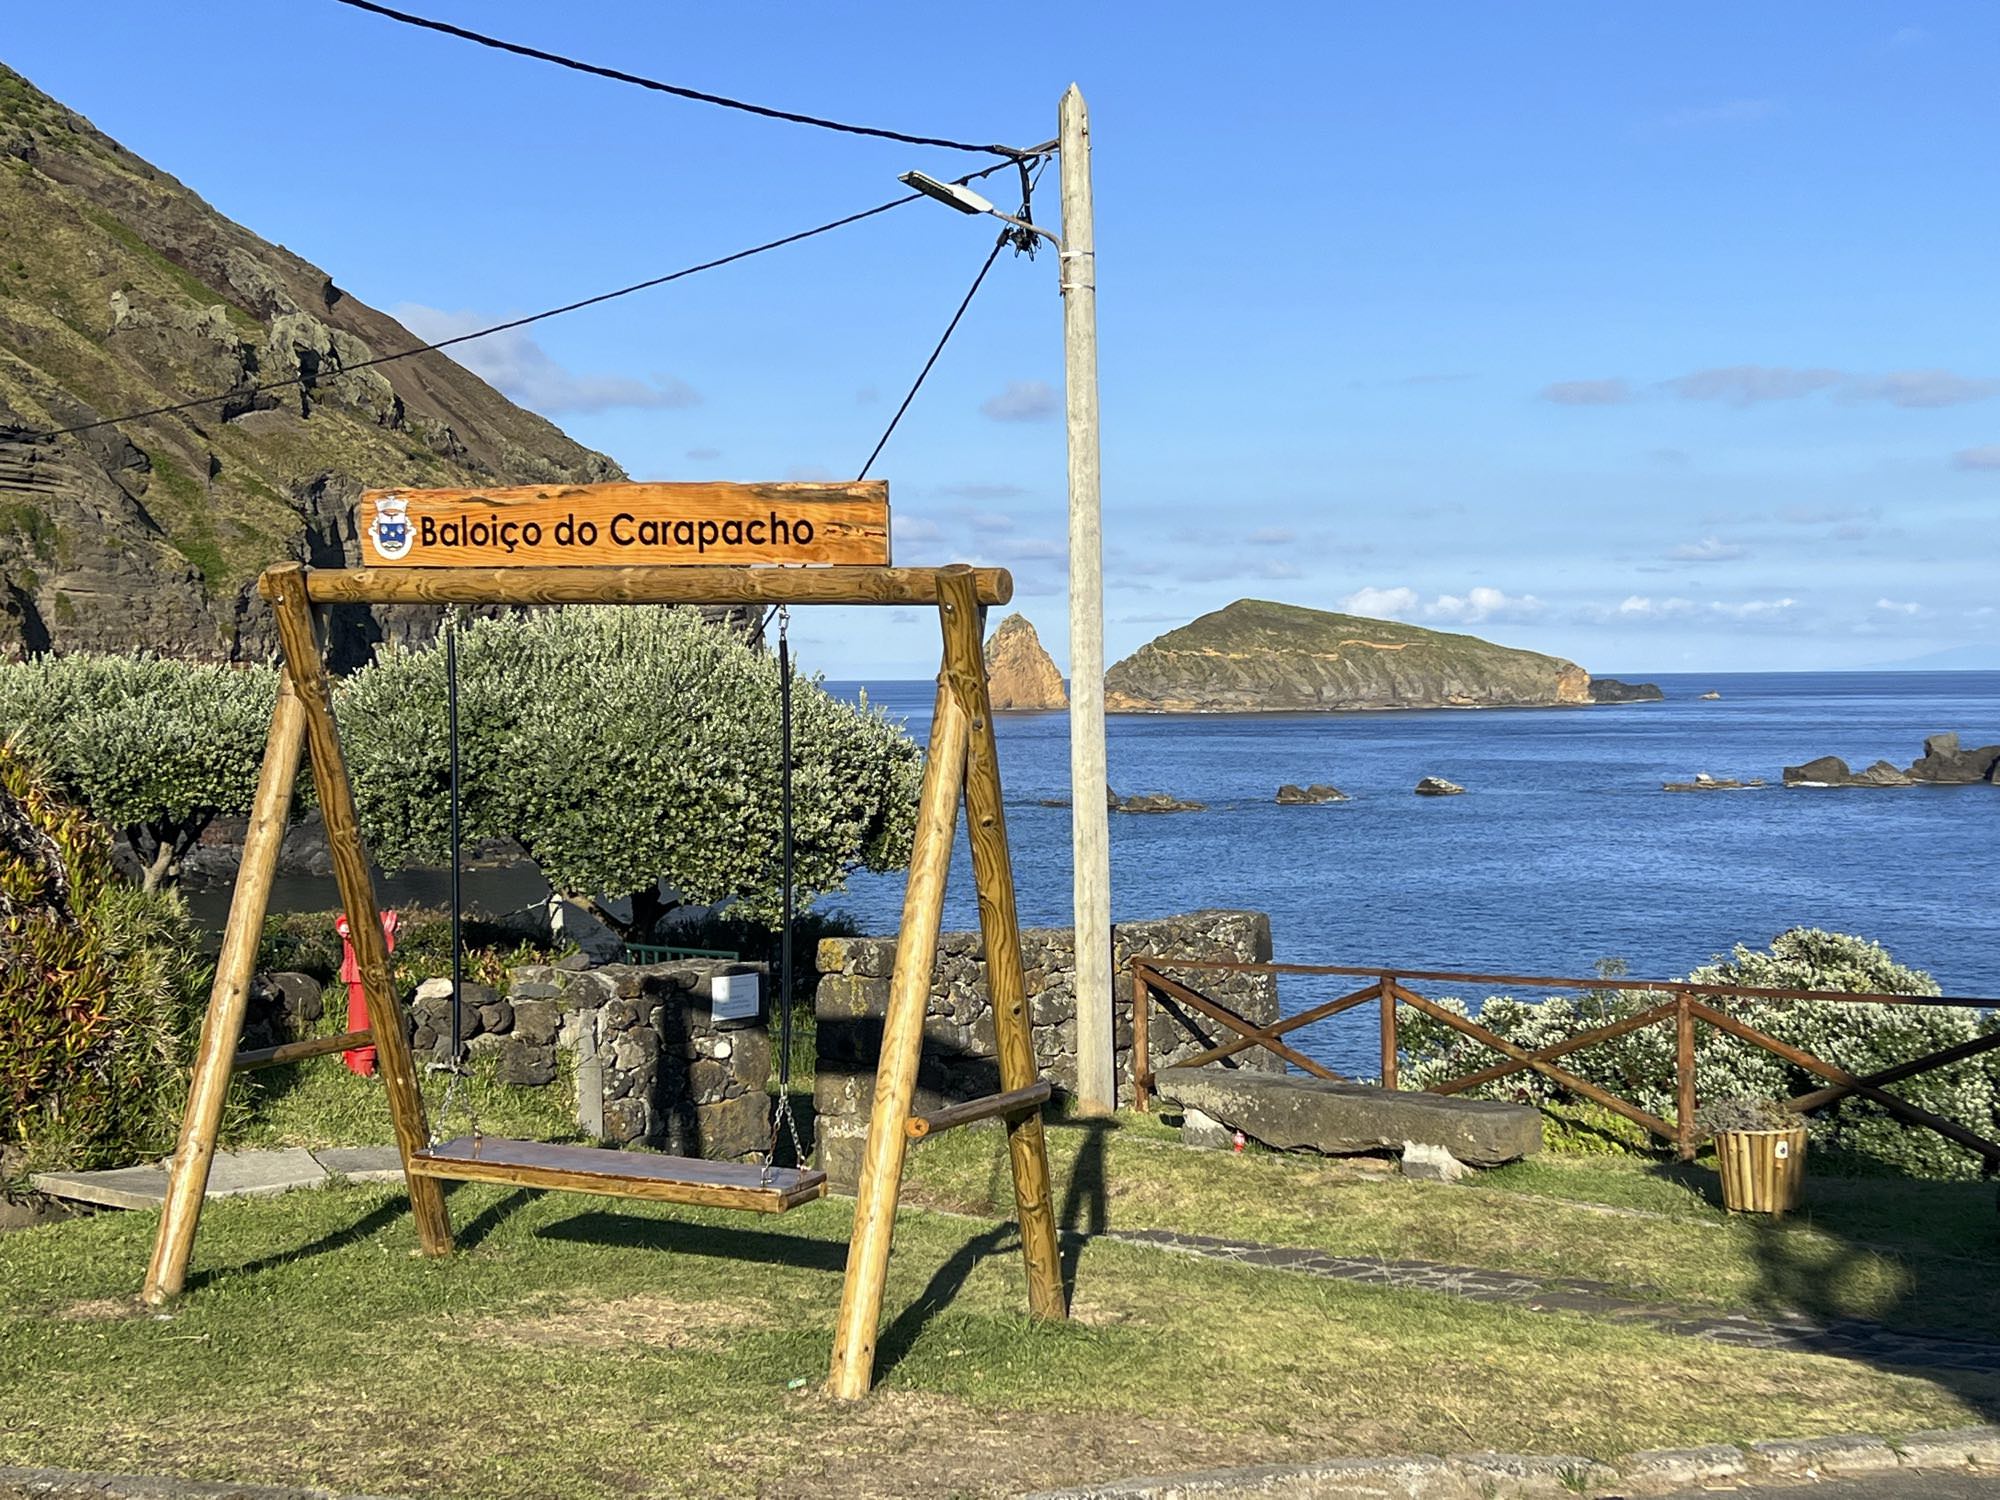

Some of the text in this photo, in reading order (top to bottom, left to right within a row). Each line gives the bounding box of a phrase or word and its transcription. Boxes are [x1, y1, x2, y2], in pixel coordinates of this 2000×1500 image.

[421, 511, 814, 553] Baloiço do Carapacho
